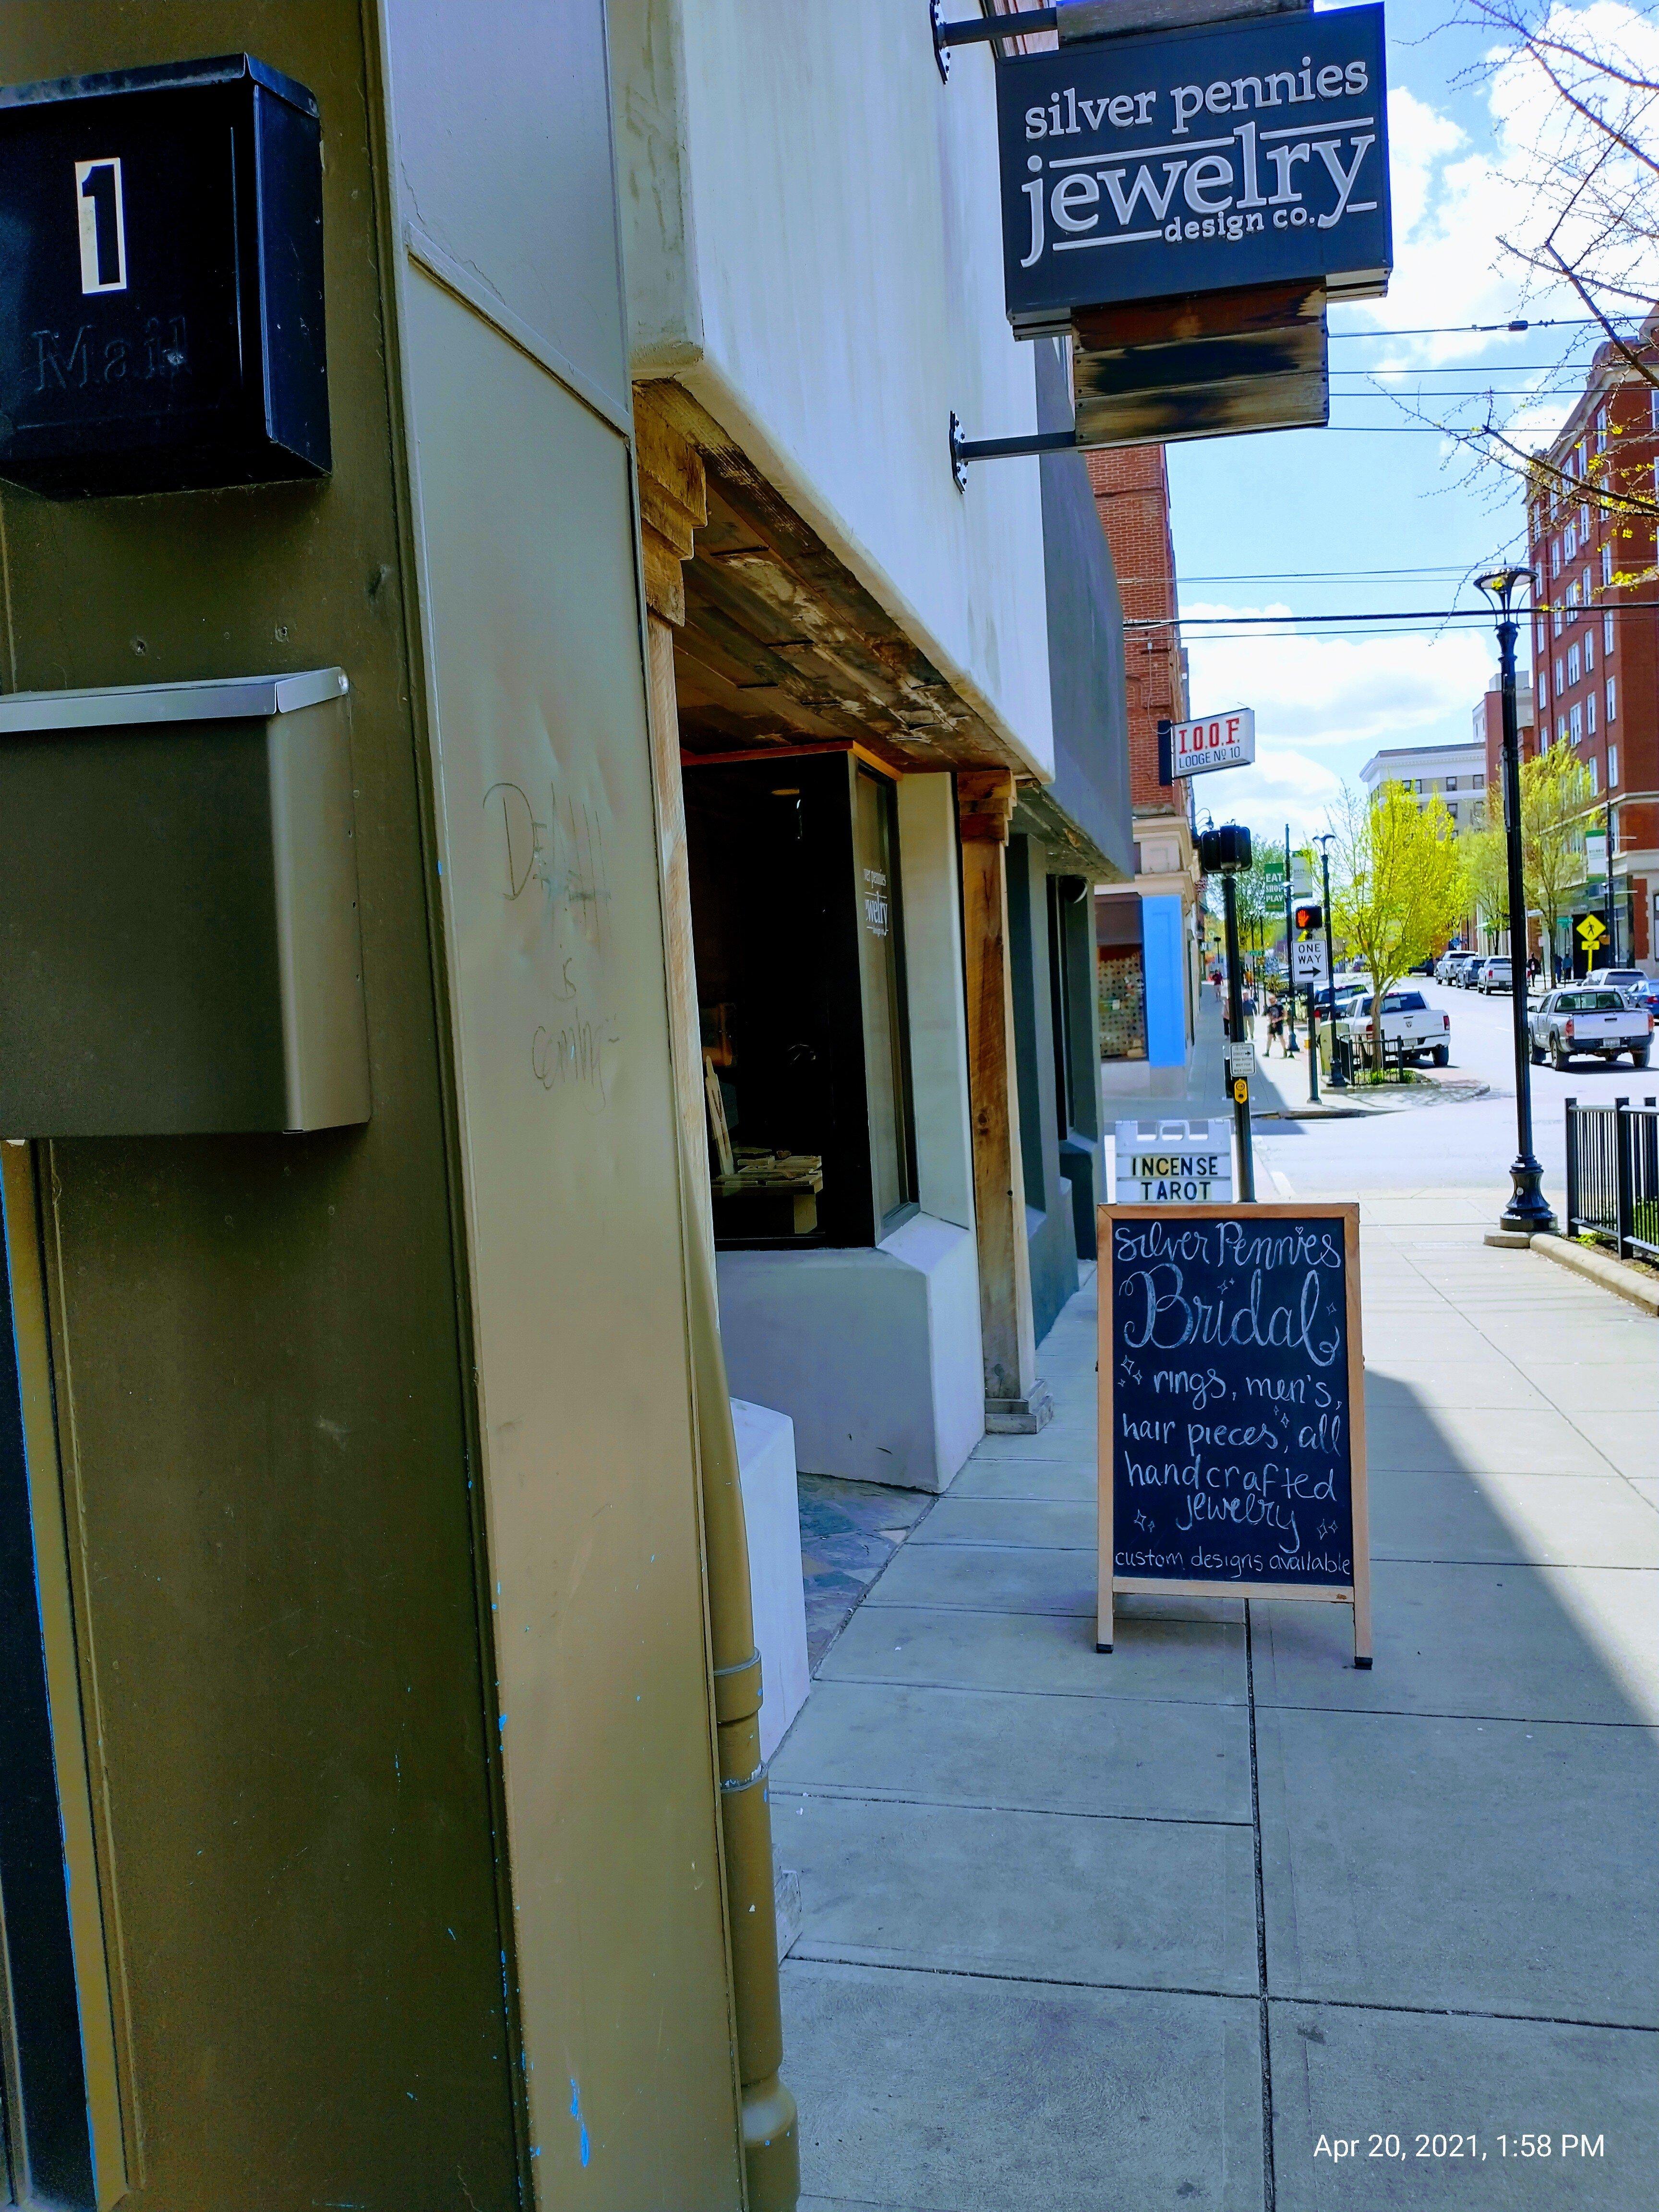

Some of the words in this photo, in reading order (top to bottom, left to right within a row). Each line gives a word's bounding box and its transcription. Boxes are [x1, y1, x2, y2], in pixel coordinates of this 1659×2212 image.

[1025, 88, 1156, 140] silver
[1170, 56, 1368, 134] pennies
[1020, 121, 1375, 268] jewelry
[82, 164, 120, 286] 1
[1165, 209, 1264, 242] design
[1274, 206, 1315, 228] co.
[1179, 752, 1211, 769] LODGE
[1230, 746, 1240, 758] 10
[1265, 873, 1283, 882] EAT
[1298, 943, 1321, 953] ONE
[1298, 954, 1322, 964] WAY
[1132, 1156, 1218, 1176] INCENSE
[1141, 1180, 1211, 1201] TAROT
[1115, 1221, 1211, 1262] Silver
[1215, 1221, 1341, 1270] Pennies
[1119, 1263, 1340, 1367] Bridal
[1154, 1368, 1237, 1410] rings,
[1245, 1374, 1343, 1410] men's,
[1122, 1413, 1176, 1443] hair
[1188, 1422, 1288, 1456] pieces,
[1298, 1413, 1341, 1457] all
[1124, 1451, 1337, 1502] handcrafted
[1115, 1549, 1184, 1567] custom
[1190, 1546, 1263, 1578] designs
[1269, 1551, 1350, 1575] available
